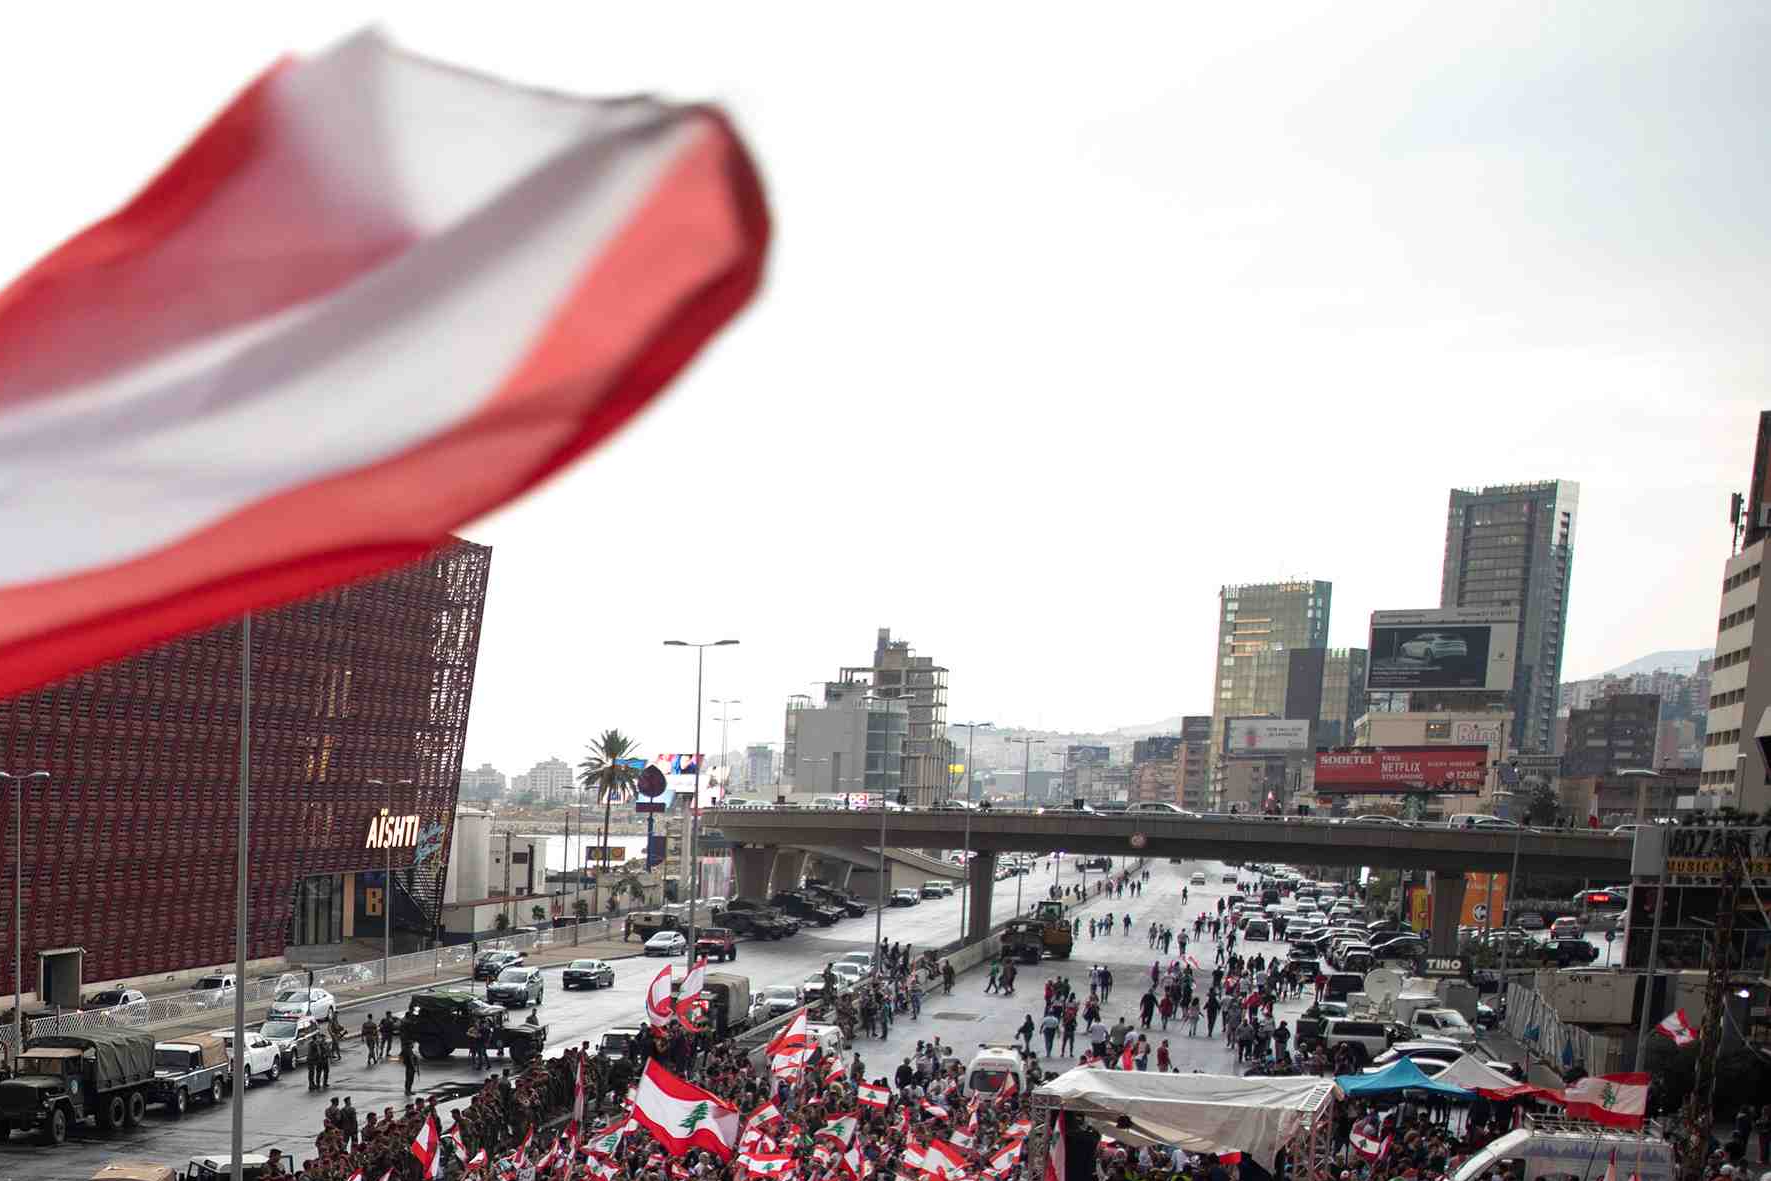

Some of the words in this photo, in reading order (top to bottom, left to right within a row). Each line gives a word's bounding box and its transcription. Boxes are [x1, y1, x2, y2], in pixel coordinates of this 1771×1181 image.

[1381, 761, 1421, 773] NETFLIX
[365, 807, 421, 849] AÏSHTI
[1428, 958, 1463, 971] TINO
